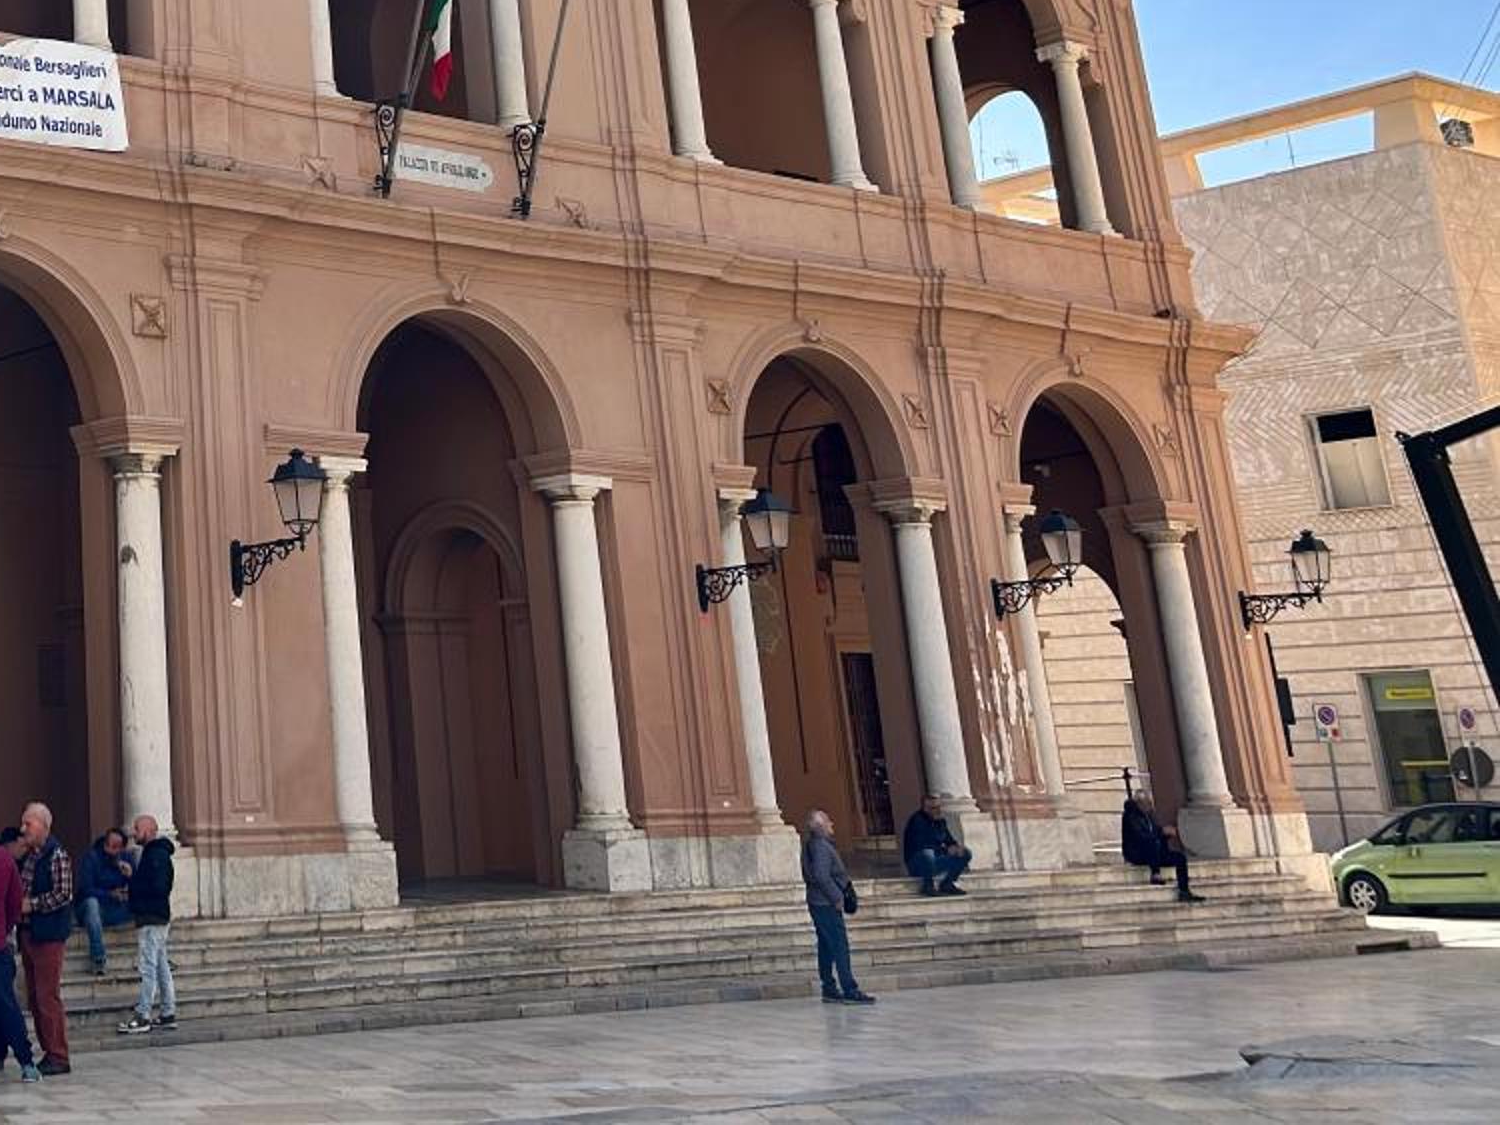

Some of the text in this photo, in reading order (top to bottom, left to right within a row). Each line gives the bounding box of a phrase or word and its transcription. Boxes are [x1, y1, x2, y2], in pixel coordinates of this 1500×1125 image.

[33, 55, 107, 80] Bersaglieri
[27, 88, 39, 104] a
[42, 86, 115, 111] MARSALA
[40, 114, 103, 138] Nazionale
